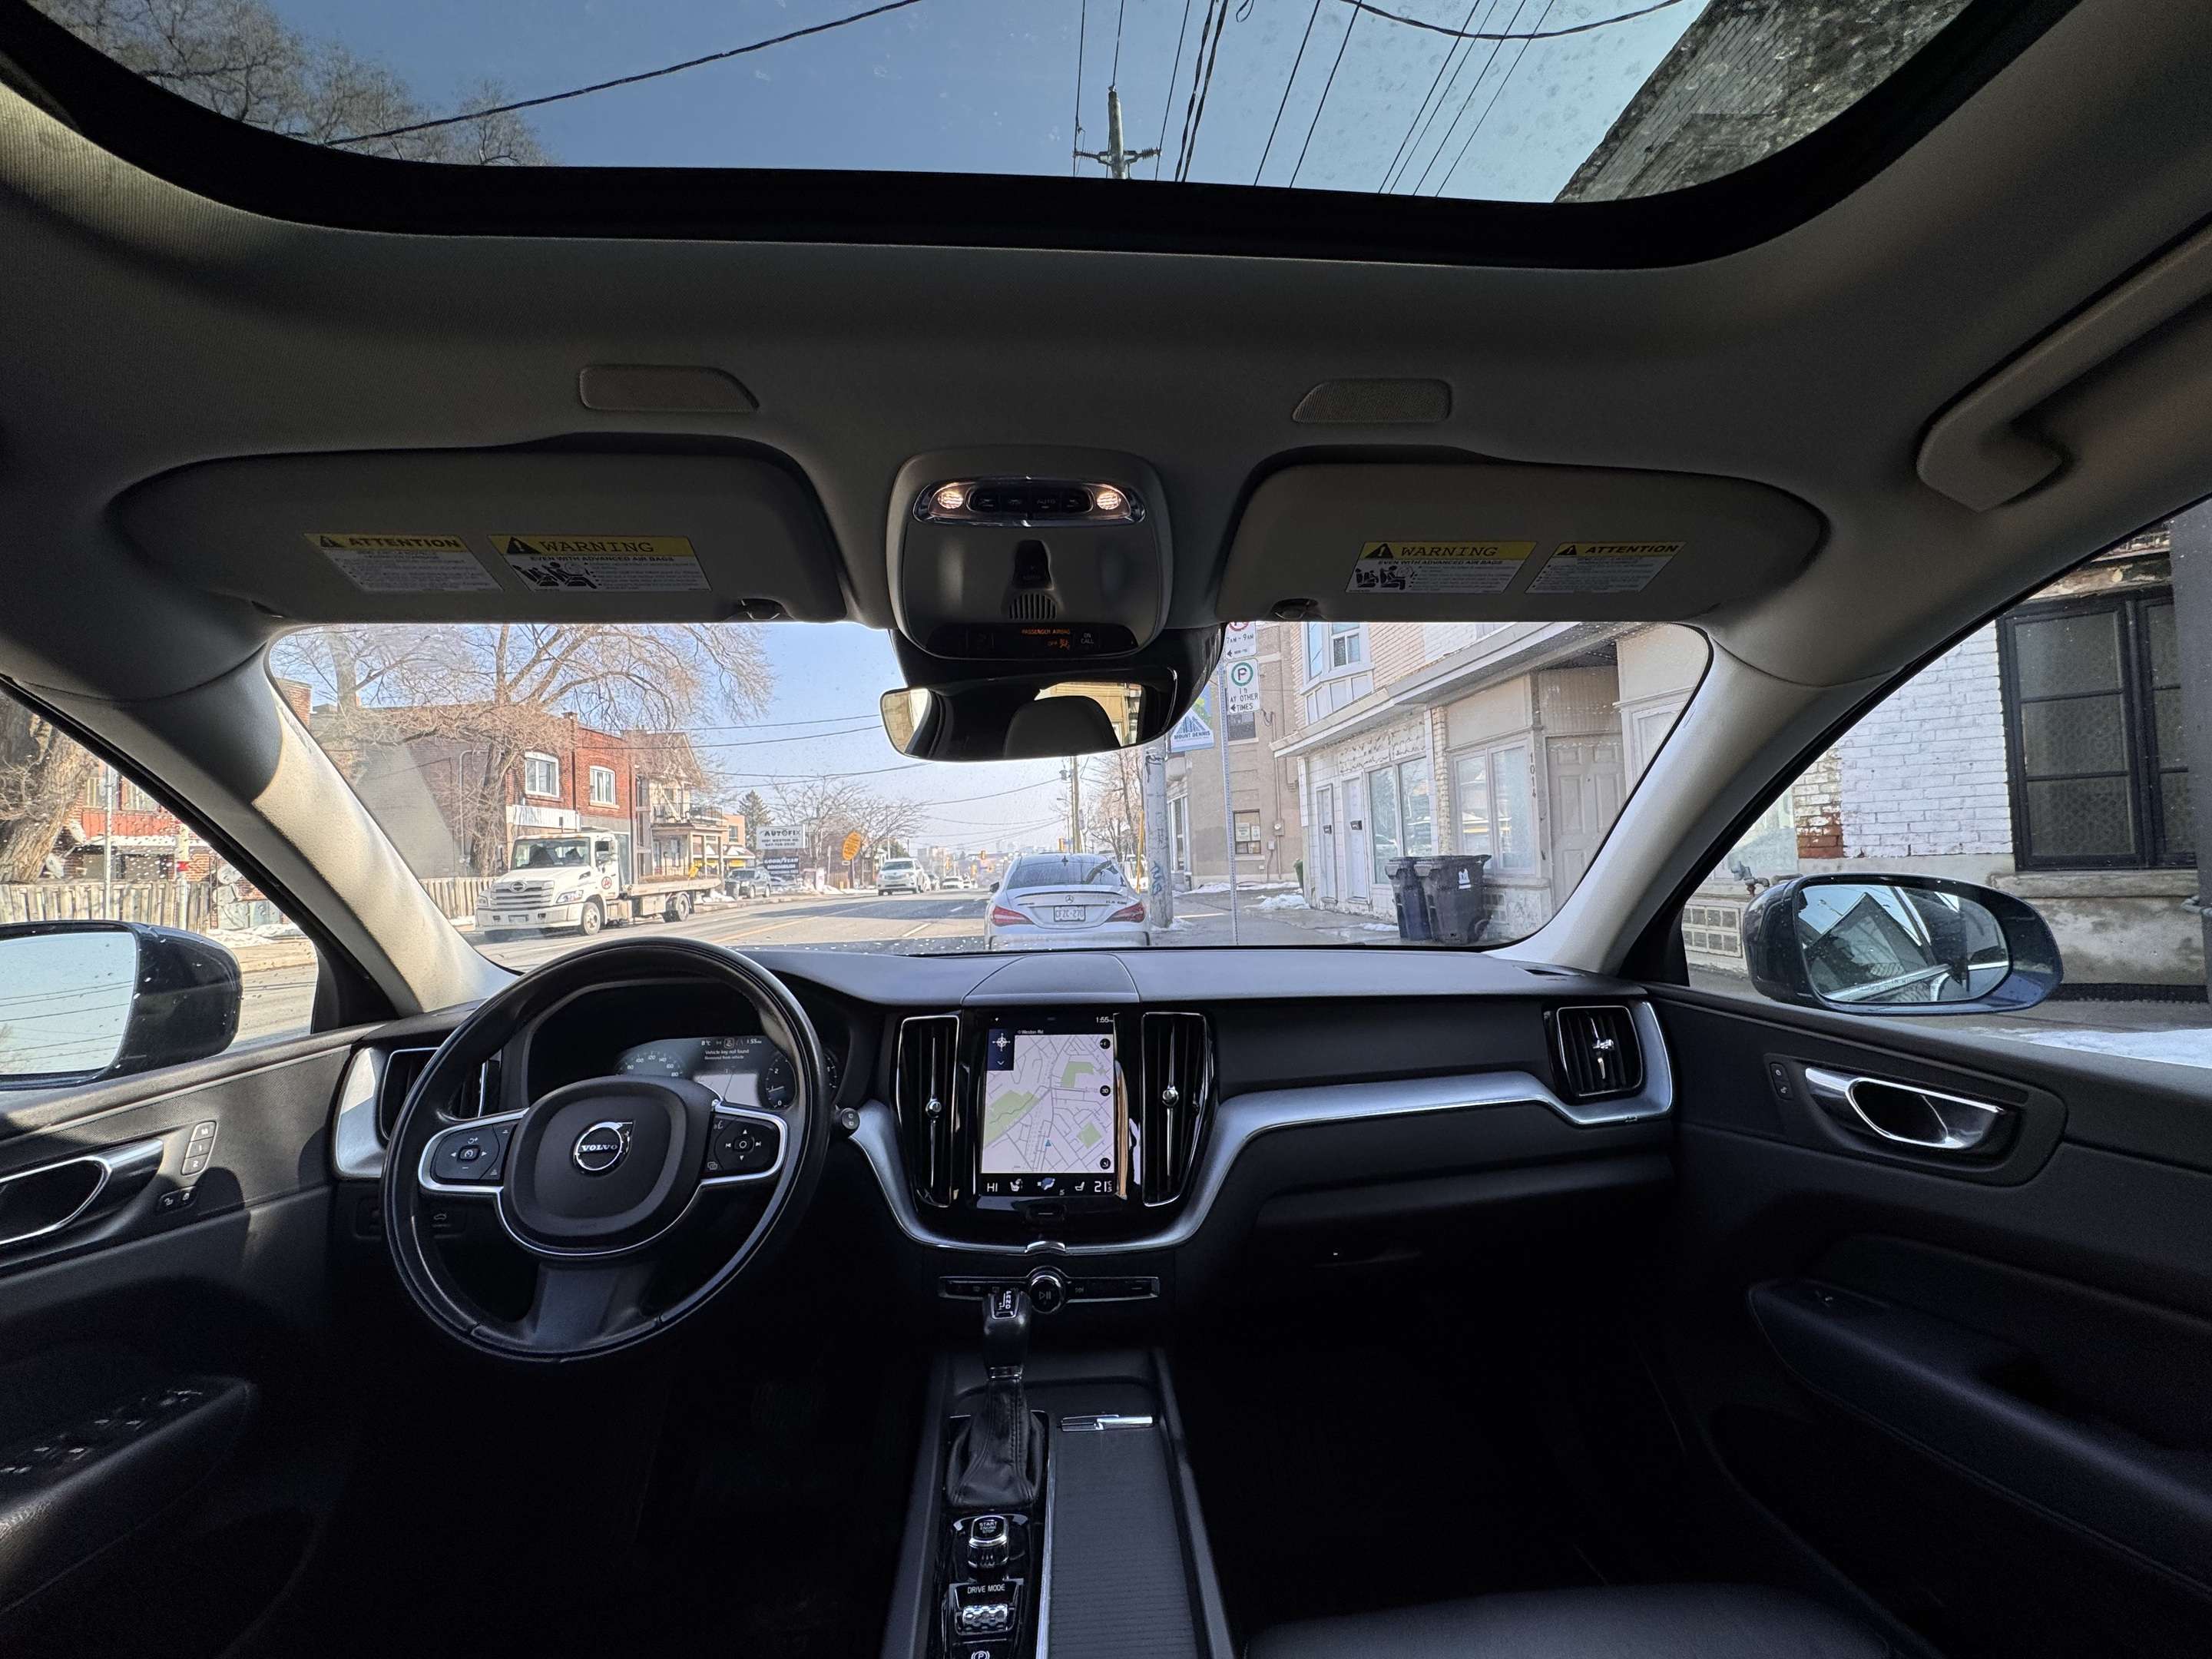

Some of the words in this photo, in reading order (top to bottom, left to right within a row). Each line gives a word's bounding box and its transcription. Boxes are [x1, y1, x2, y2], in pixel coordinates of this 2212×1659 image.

[349, 537, 461, 548] ATTENTION
[539, 541, 654, 553] WARNING
[1400, 546, 1499, 557] WARNING
[1584, 545, 1680, 554] ATTENTION
[1237, 667, 1247, 680] P
[1240, 693, 1259, 702] OTHER
[987, 1183, 998, 1192] HI
[967, 1585, 985, 1594] DRIVE
[988, 1584, 1005, 1592] MODE
